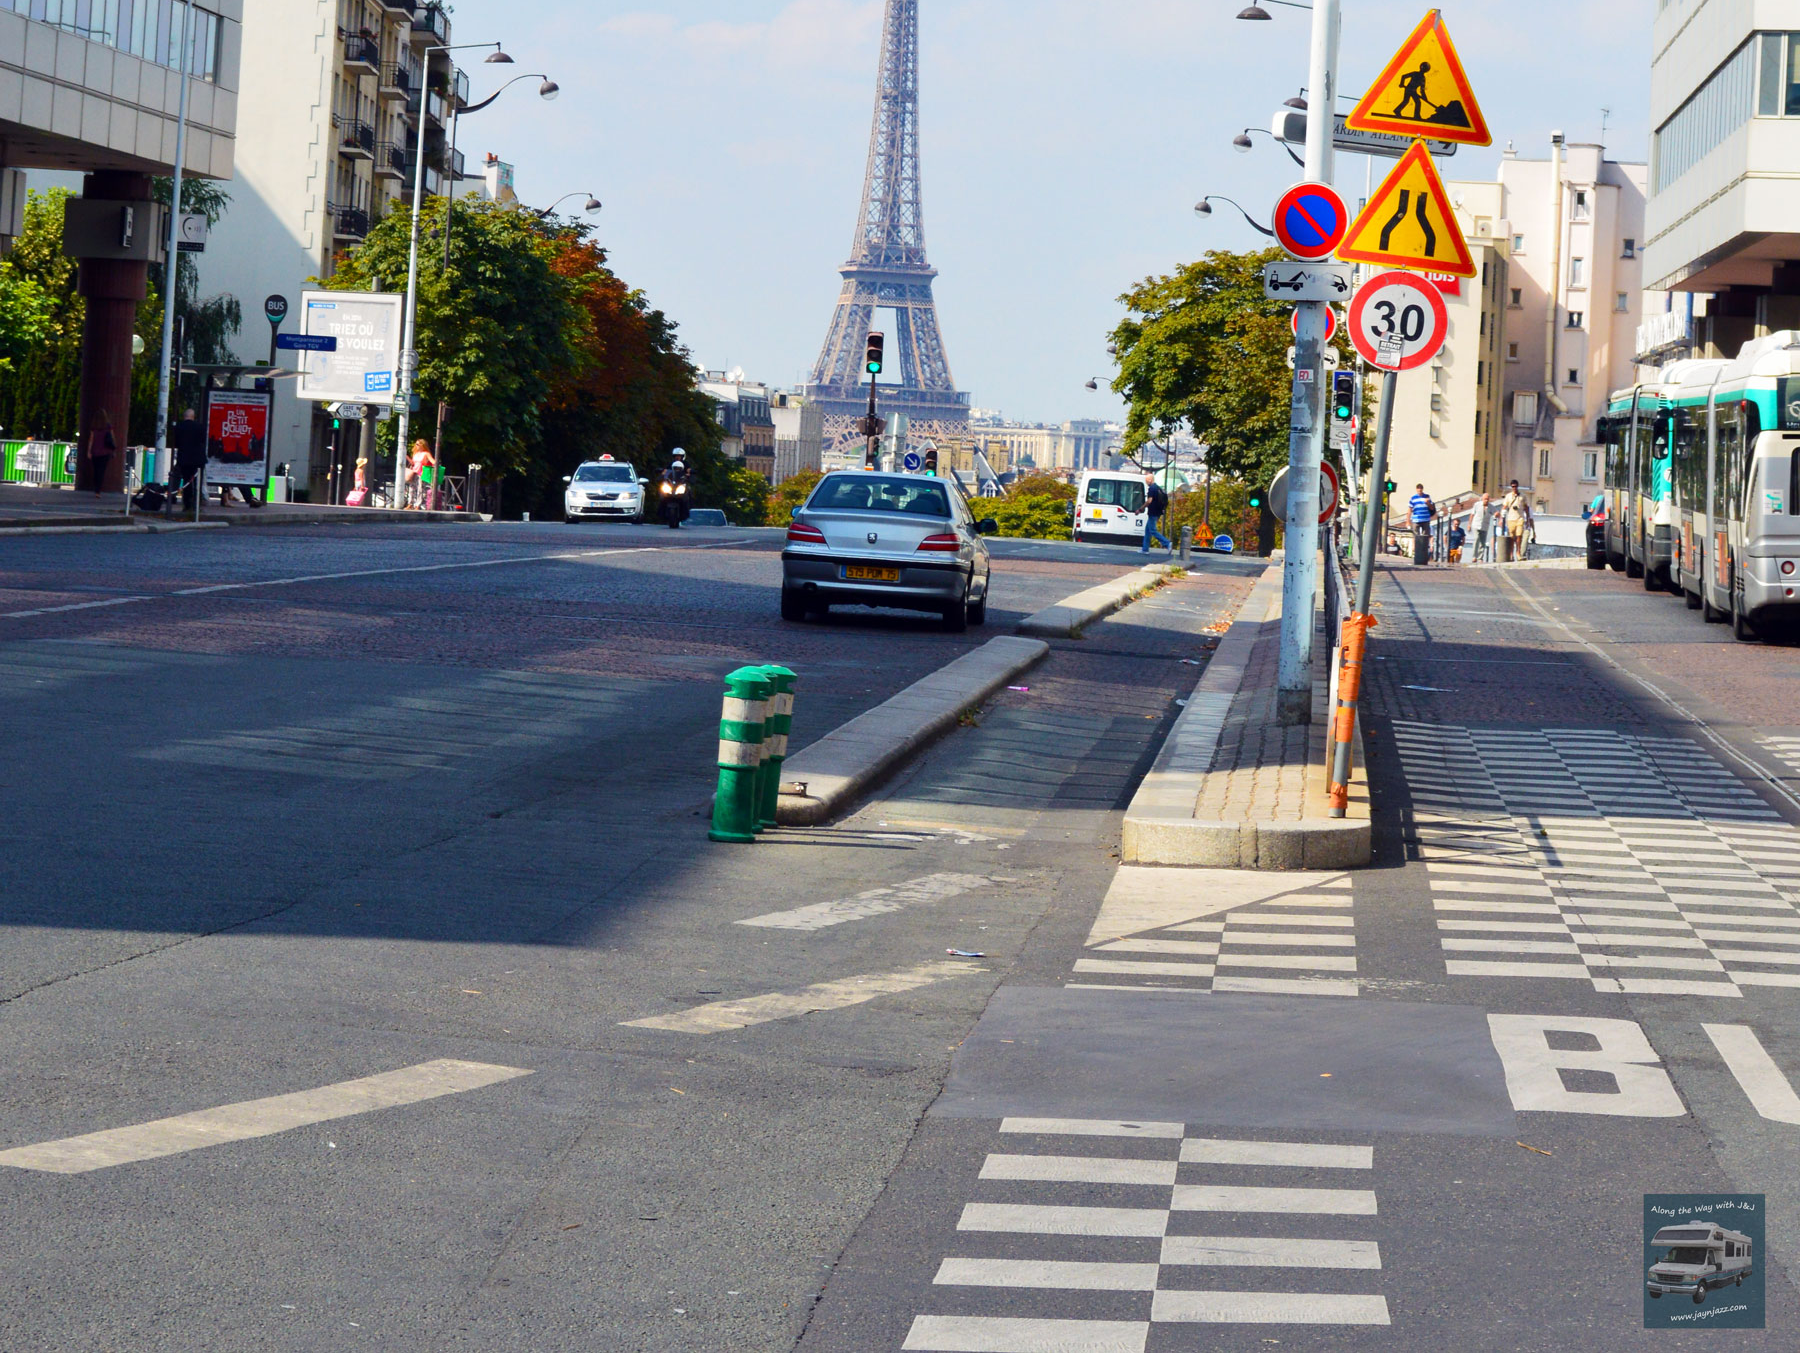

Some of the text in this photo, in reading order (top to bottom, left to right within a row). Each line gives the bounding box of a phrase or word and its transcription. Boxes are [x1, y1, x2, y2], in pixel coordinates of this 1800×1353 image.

[1333, 123, 1364, 137] ARDIN
[268, 301, 284, 310] BUS
[1371, 300, 1424, 341] 30
[329, 322, 374, 335] TRIEZ OÙ
[346, 338, 385, 350] VOULEZ
[227, 411, 248, 424] PETIT
[222, 421, 252, 437] BOULOT
